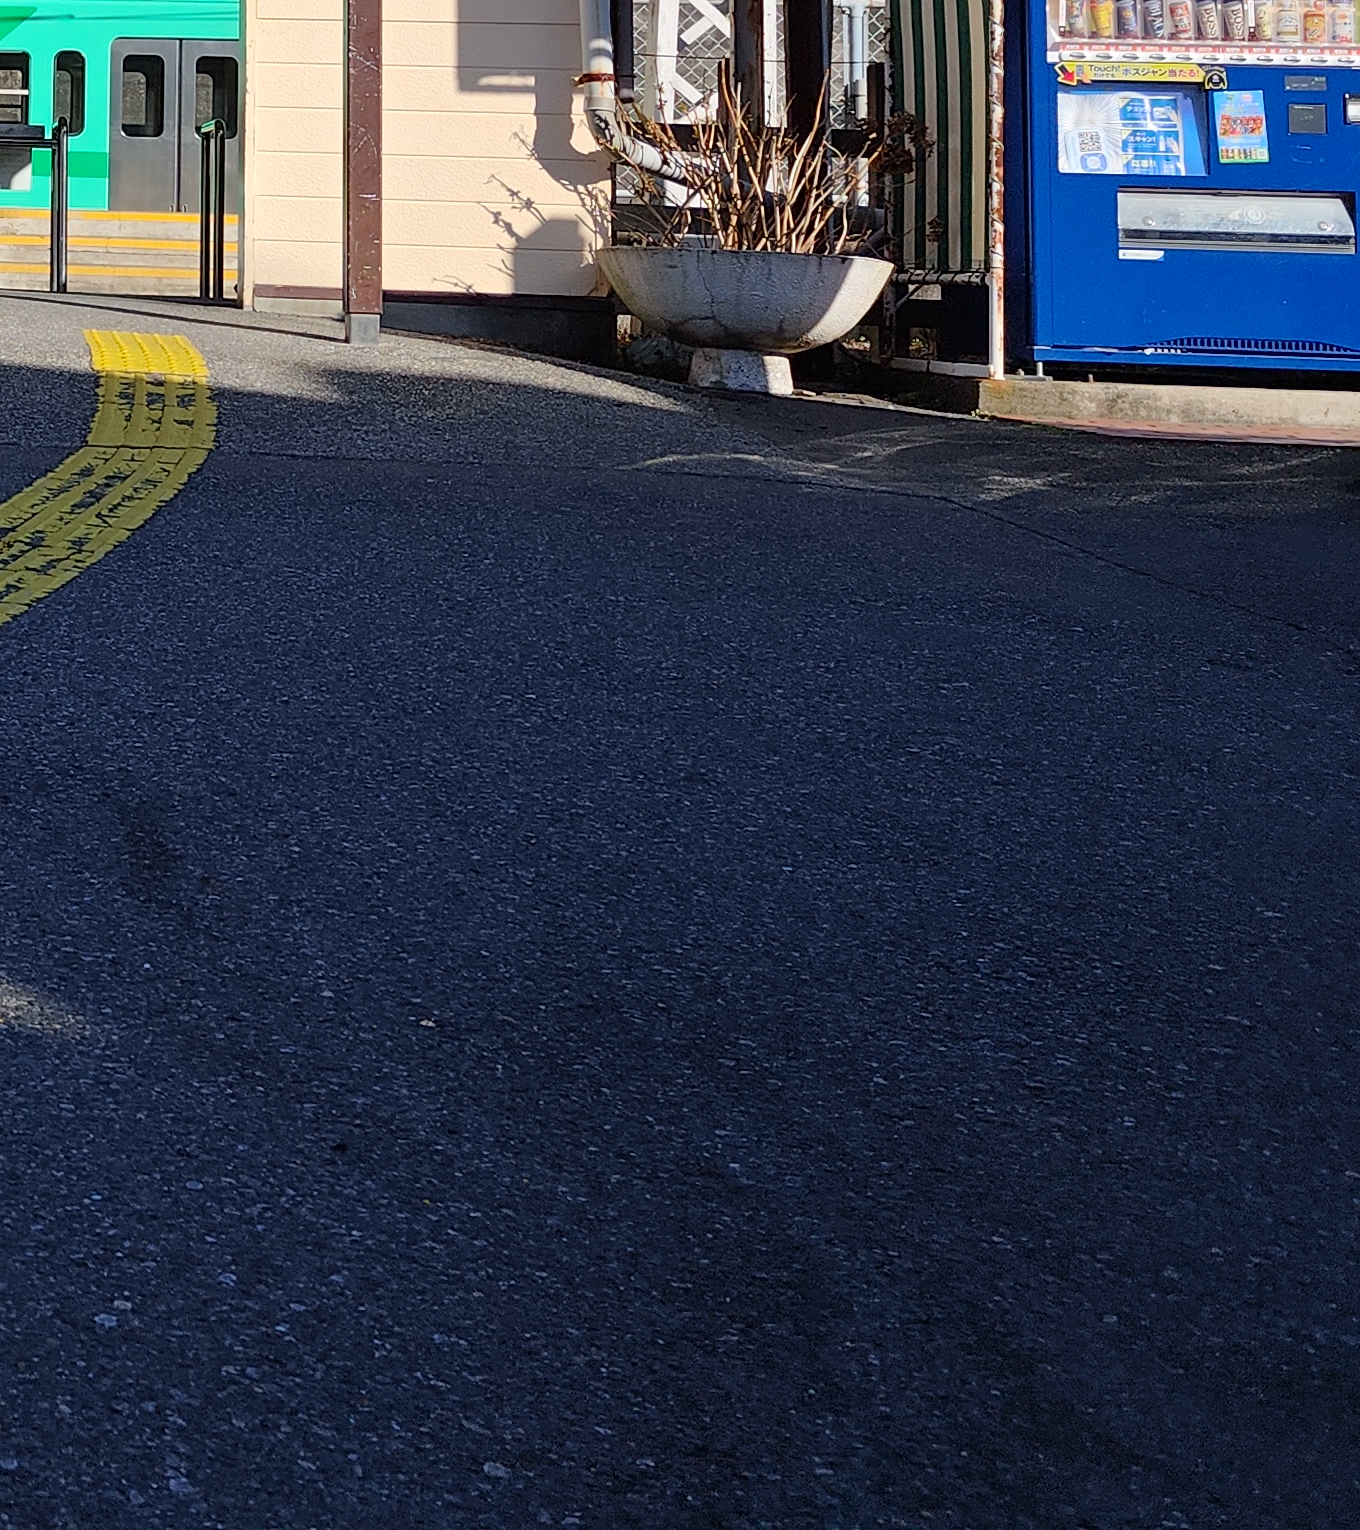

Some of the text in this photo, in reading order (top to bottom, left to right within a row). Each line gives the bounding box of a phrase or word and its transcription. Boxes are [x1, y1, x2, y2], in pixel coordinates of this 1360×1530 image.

[1204, 6, 1217, 36] BOSS
[1231, 7, 1244, 36] BOSS
[1087, 64, 1121, 73] Touch!
